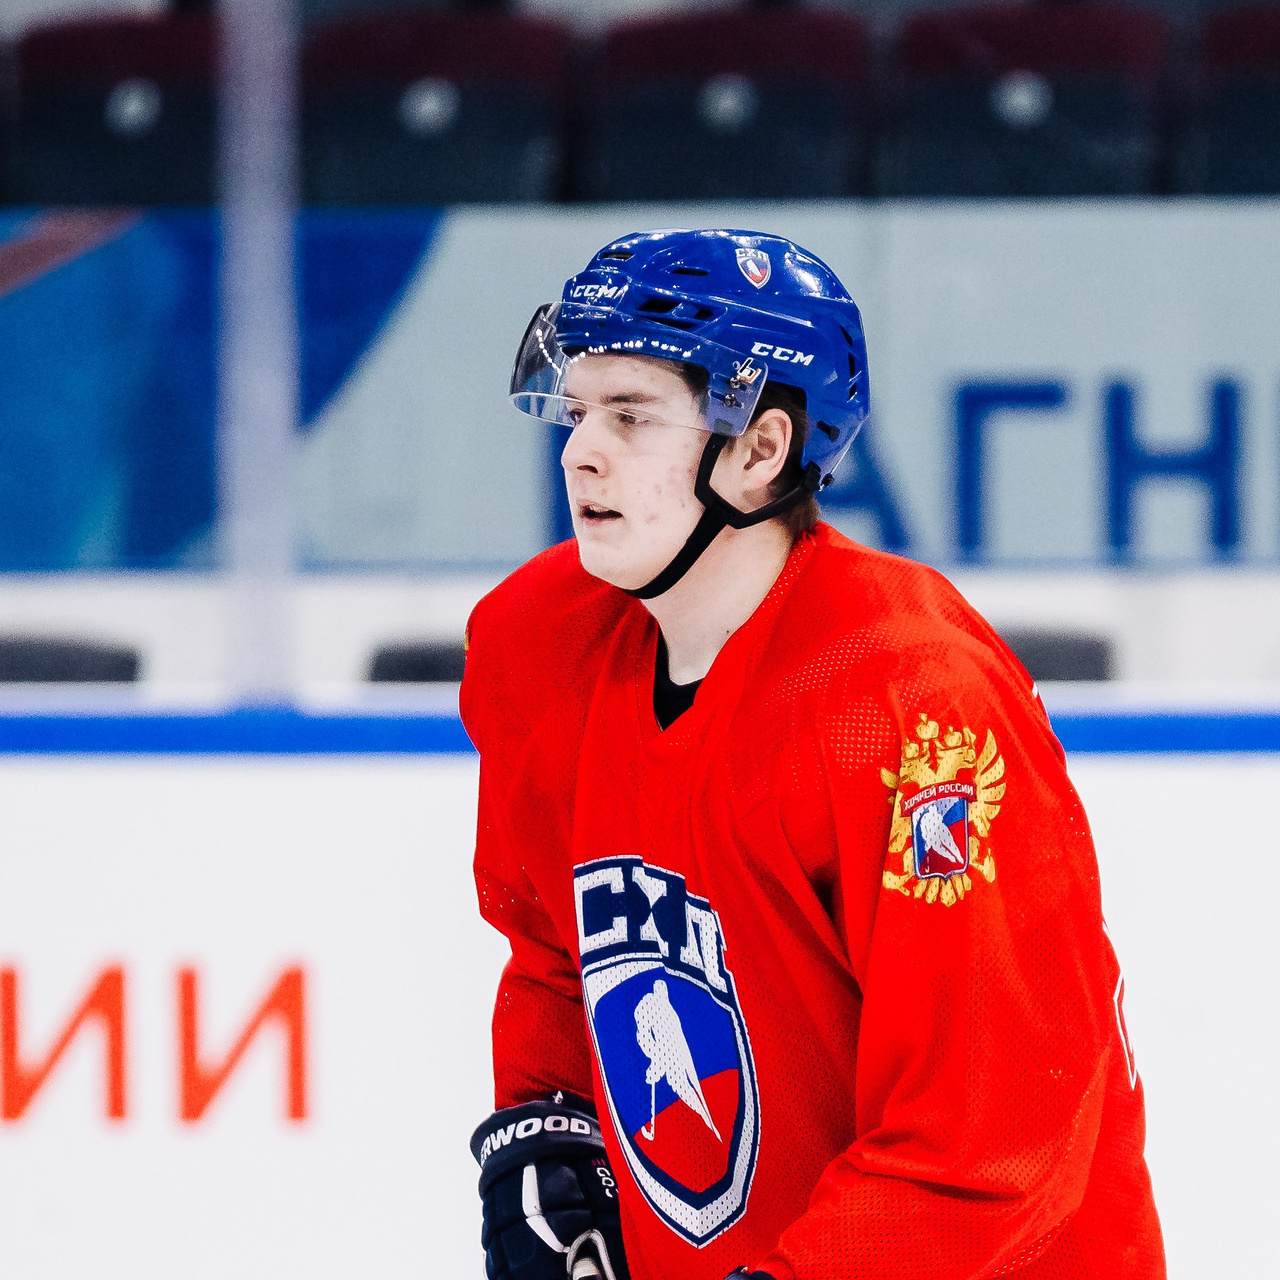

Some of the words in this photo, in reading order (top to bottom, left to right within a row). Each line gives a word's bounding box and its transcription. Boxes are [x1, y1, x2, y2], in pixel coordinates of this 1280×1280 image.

[573, 285, 618, 298] CCM
[750, 342, 814, 366] CCM
[904, 786, 937, 810] ХОККЕЙ
[938, 783, 973, 796] РОССИИ
